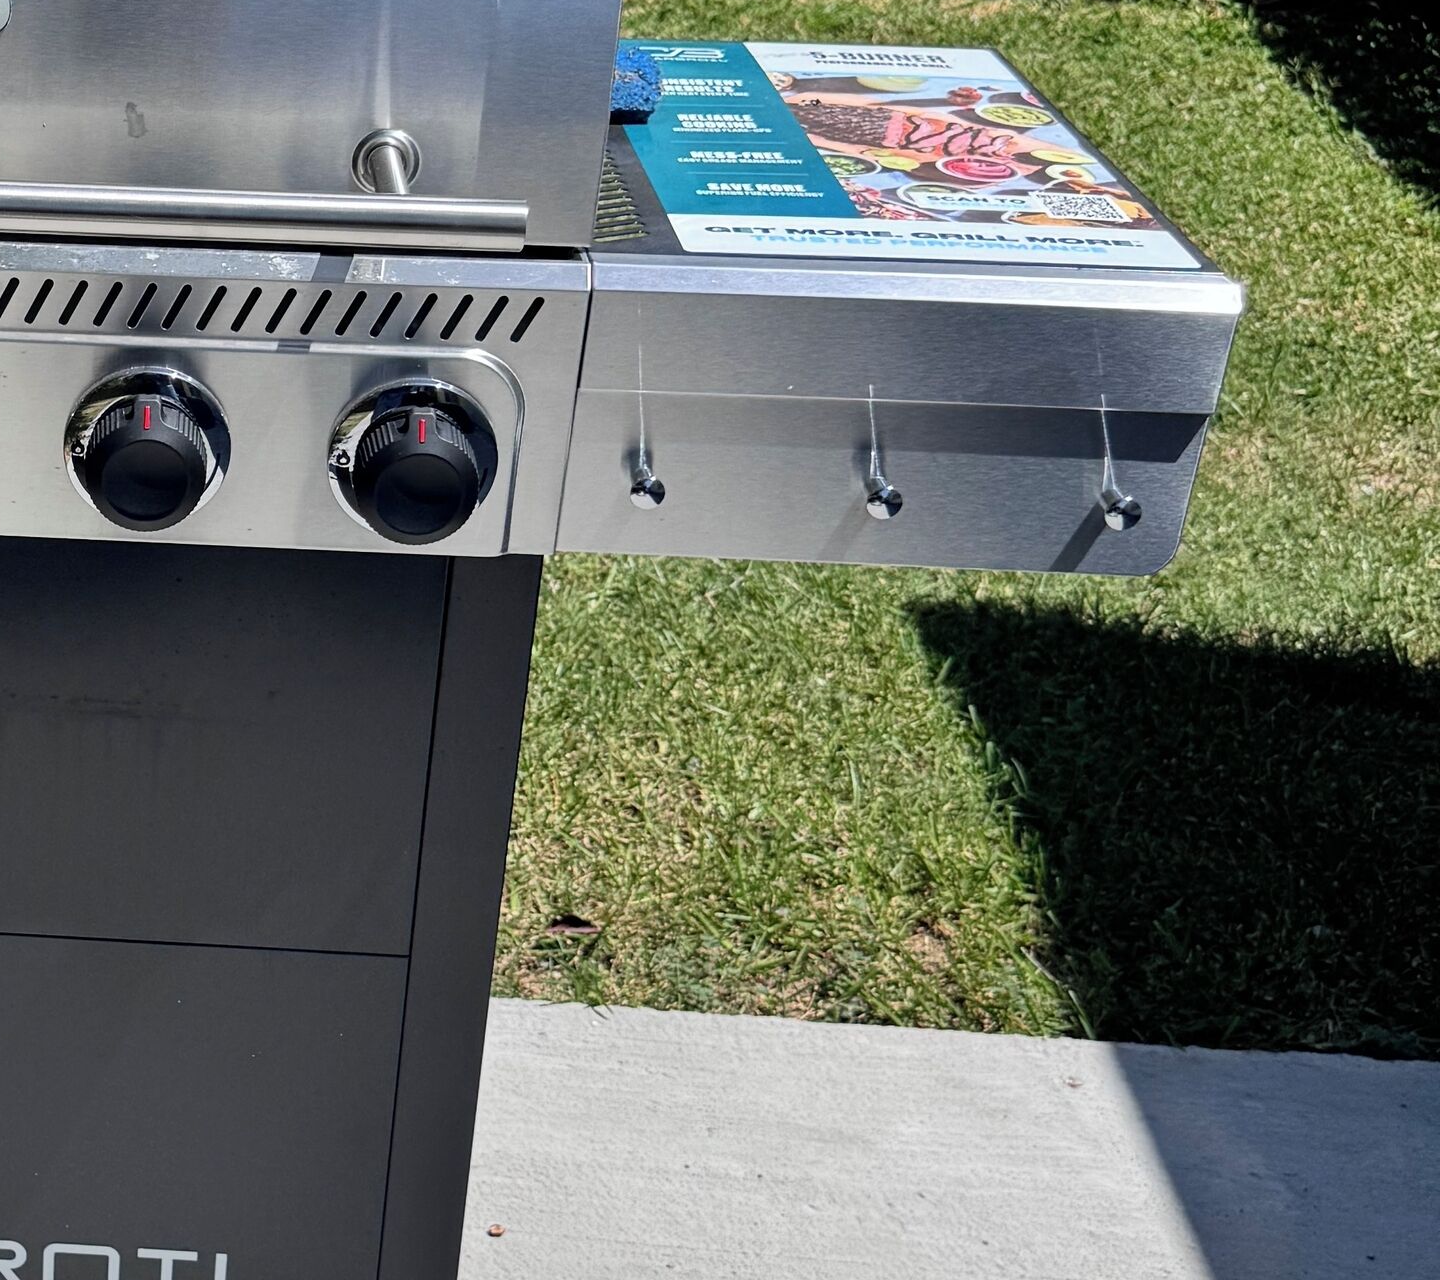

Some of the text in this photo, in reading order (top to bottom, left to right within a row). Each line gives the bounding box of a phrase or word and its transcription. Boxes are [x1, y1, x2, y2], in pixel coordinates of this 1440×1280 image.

[809, 51, 947, 64] 5-BURNER
[676, 113, 754, 122] RELIABLE
[689, 151, 785, 160] MESS-FREE
[706, 182, 807, 192] SAVE MORE
[927, 195, 989, 203] SCAN
[704, 226, 776, 234] GET
[784, 228, 903, 238] MORE.
[911, 232, 1019, 242] GRILL
[750, 234, 1110, 254] TRUSTED PERFORMANCE
